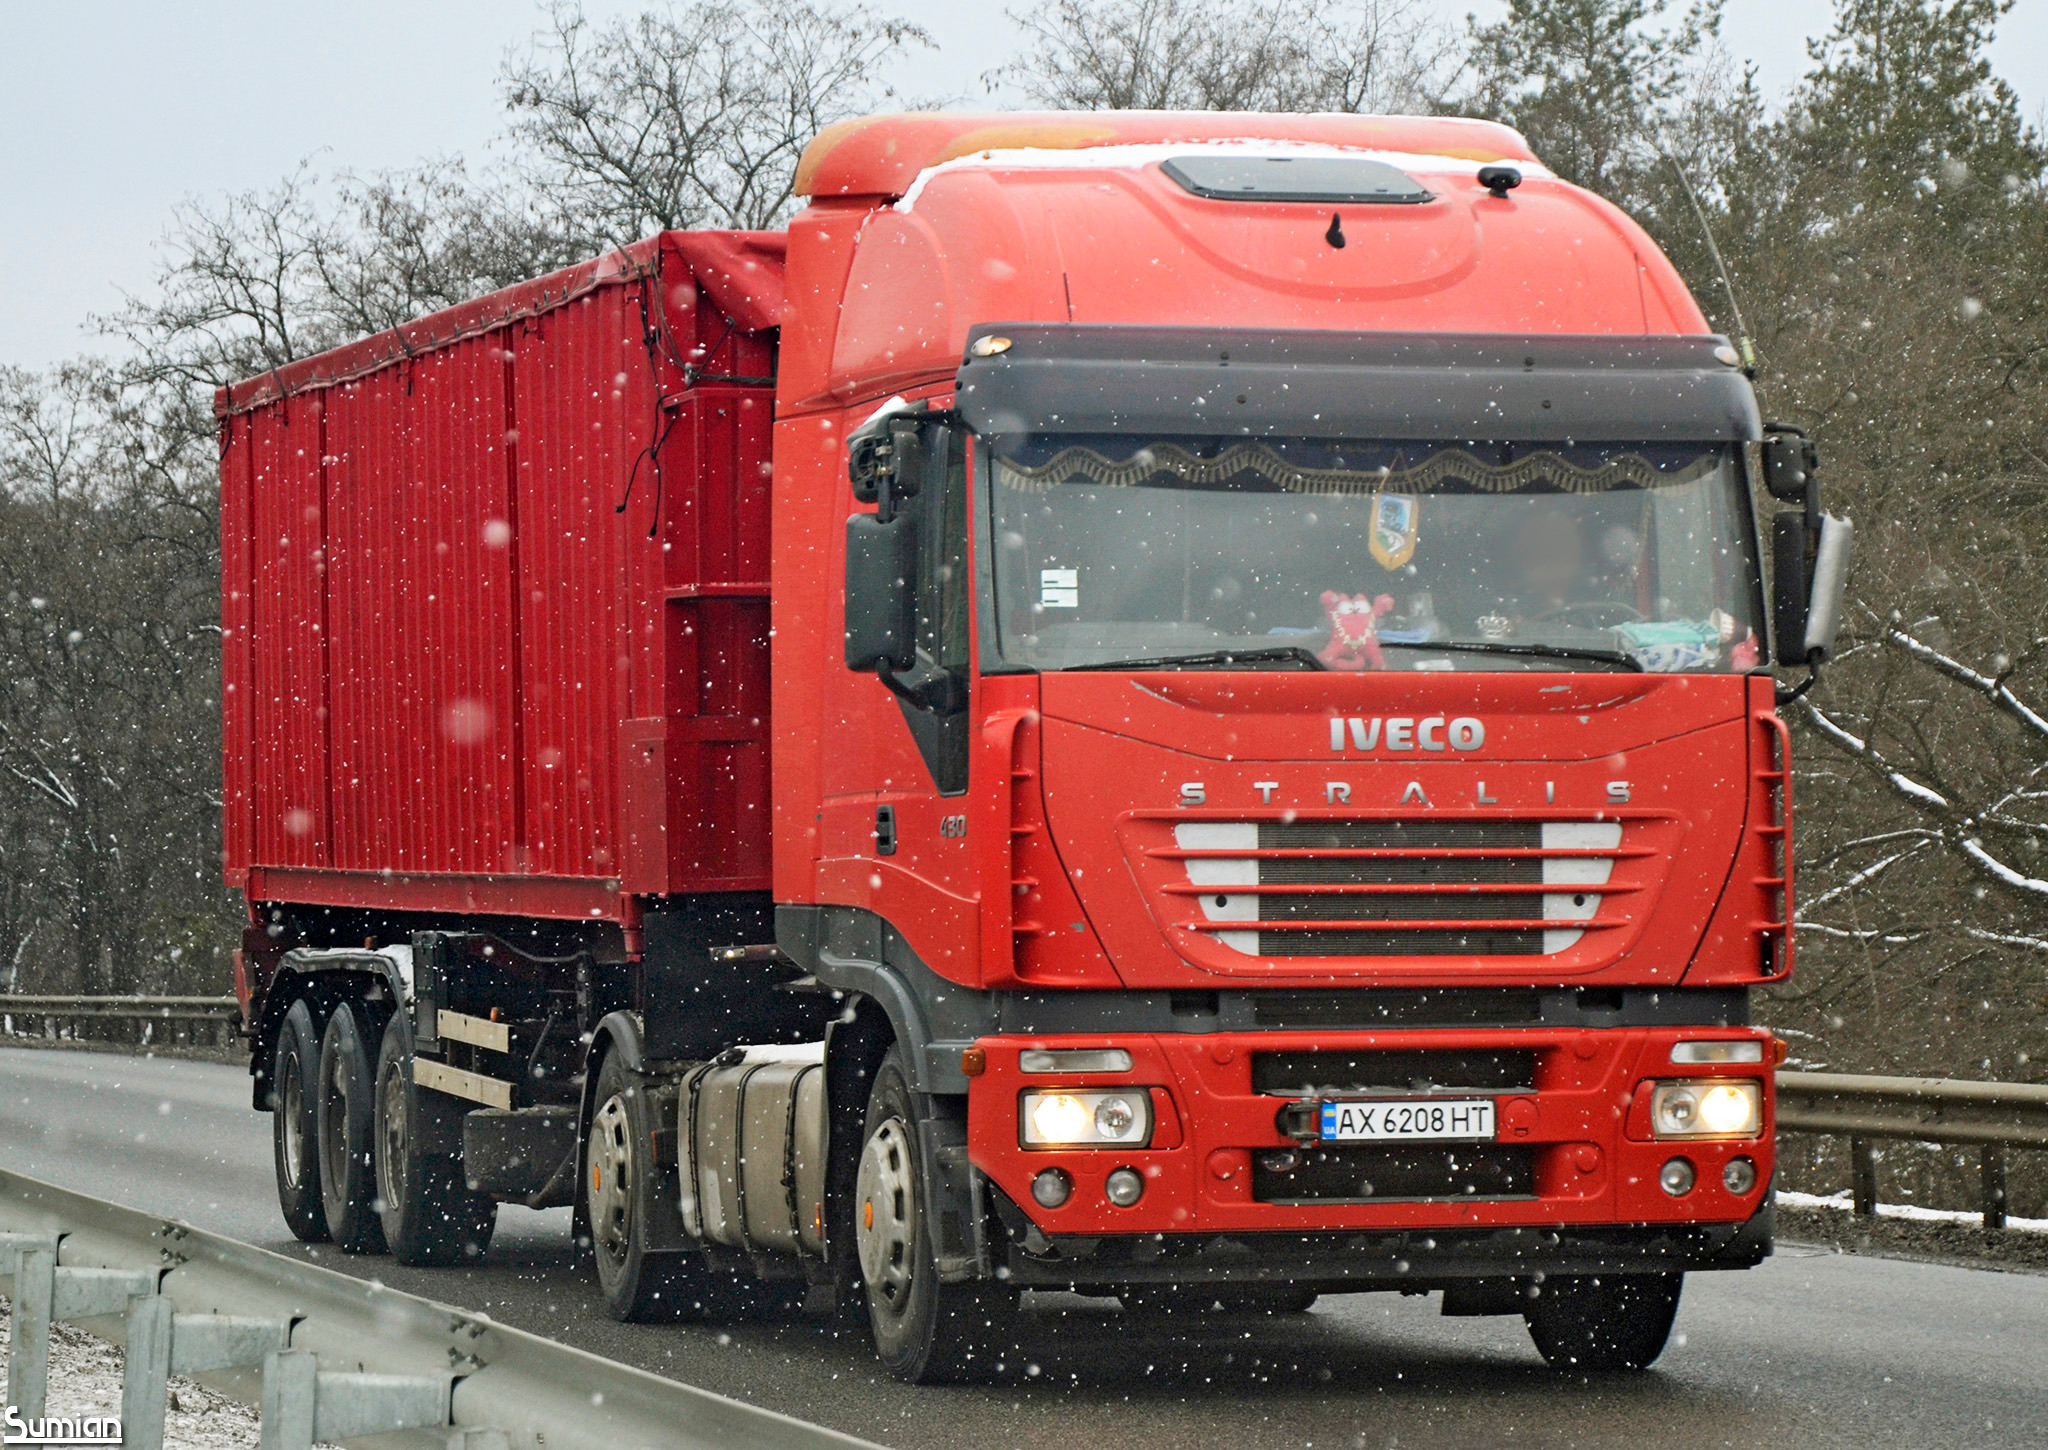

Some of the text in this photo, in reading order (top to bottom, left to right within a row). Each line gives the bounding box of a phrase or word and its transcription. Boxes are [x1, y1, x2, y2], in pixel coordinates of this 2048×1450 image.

[1329, 716, 1486, 752] IVECO
[1179, 780, 1632, 806] STRALIS
[1323, 1126, 1335, 1135] UA
[1339, 1106, 1489, 1134] AX 6208 HT
